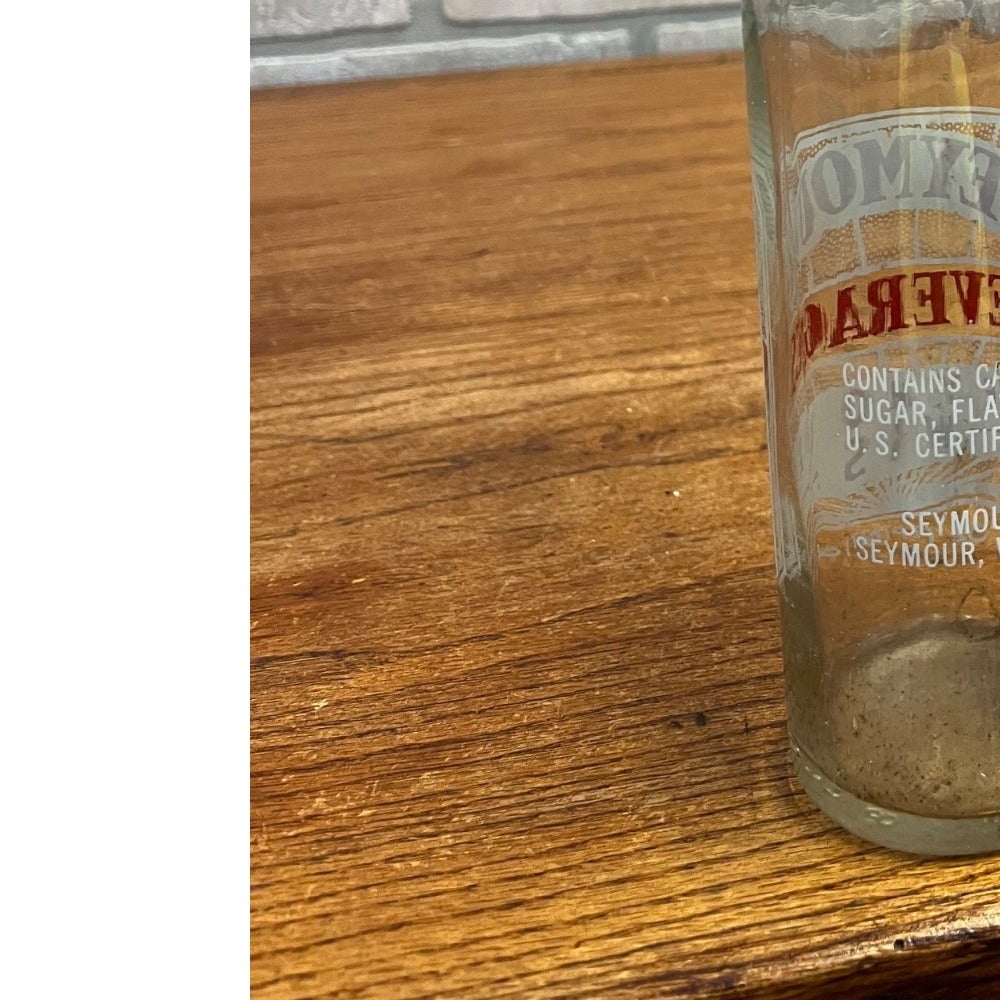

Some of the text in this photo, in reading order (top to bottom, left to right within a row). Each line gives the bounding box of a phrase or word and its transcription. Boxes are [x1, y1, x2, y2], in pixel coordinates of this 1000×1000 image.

[842, 362, 962, 394] CONTAINS
[845, 394, 938, 431] SUGAR,
[855, 536, 985, 568] SEYMOUR,
